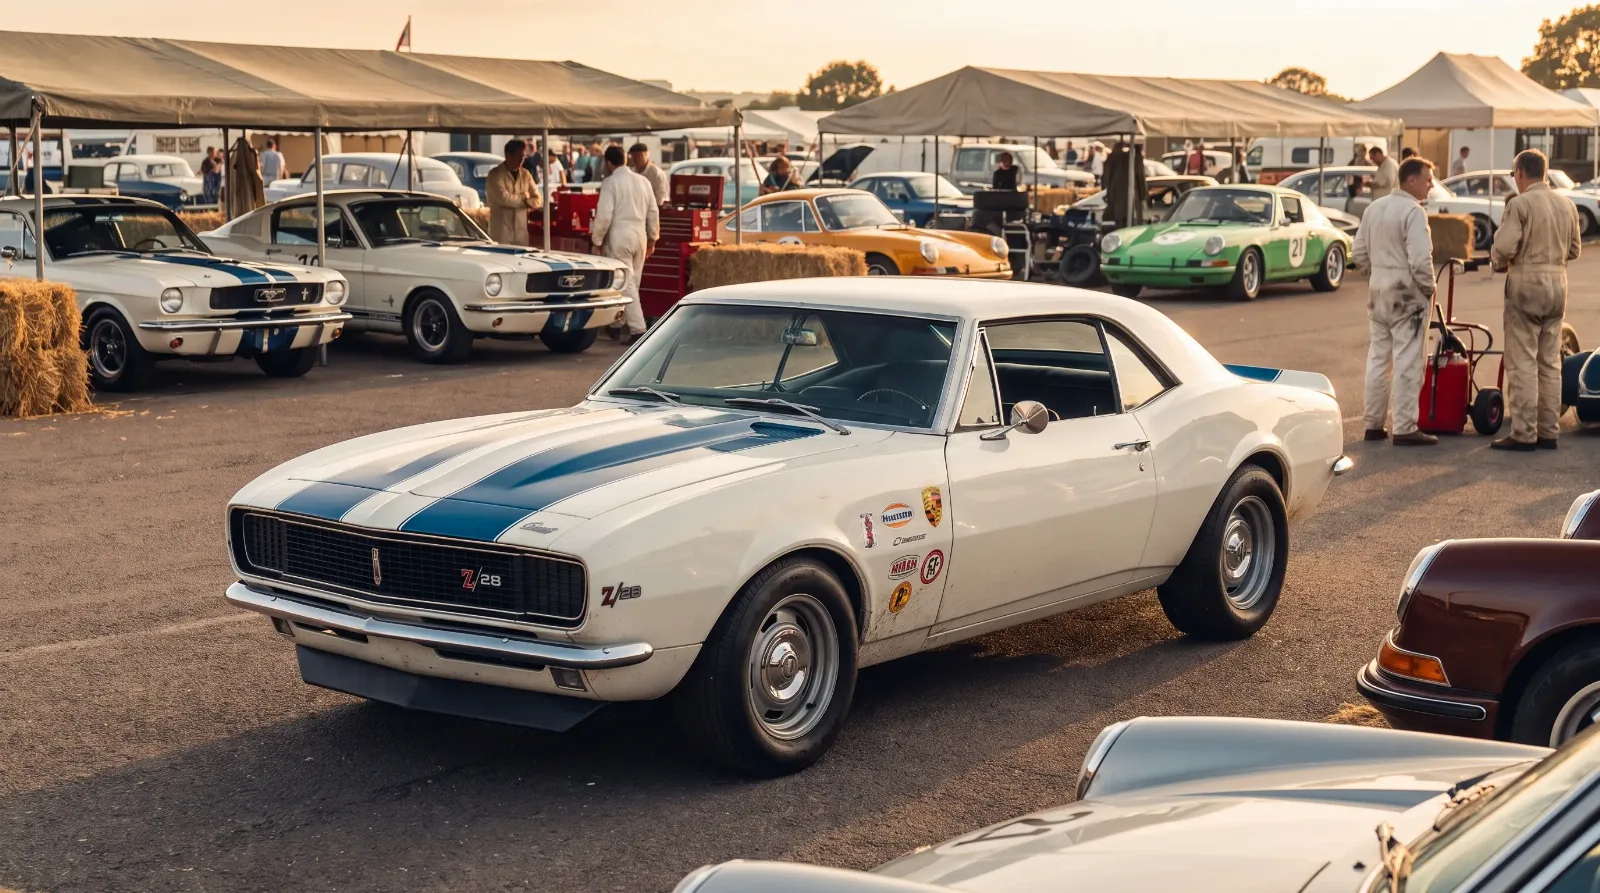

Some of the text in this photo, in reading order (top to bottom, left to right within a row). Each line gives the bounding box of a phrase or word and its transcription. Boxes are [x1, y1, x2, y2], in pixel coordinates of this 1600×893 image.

[1291, 237, 1303, 258] 21
[461, 566, 501, 592] Z/28
[601, 582, 642, 608] Z/28
